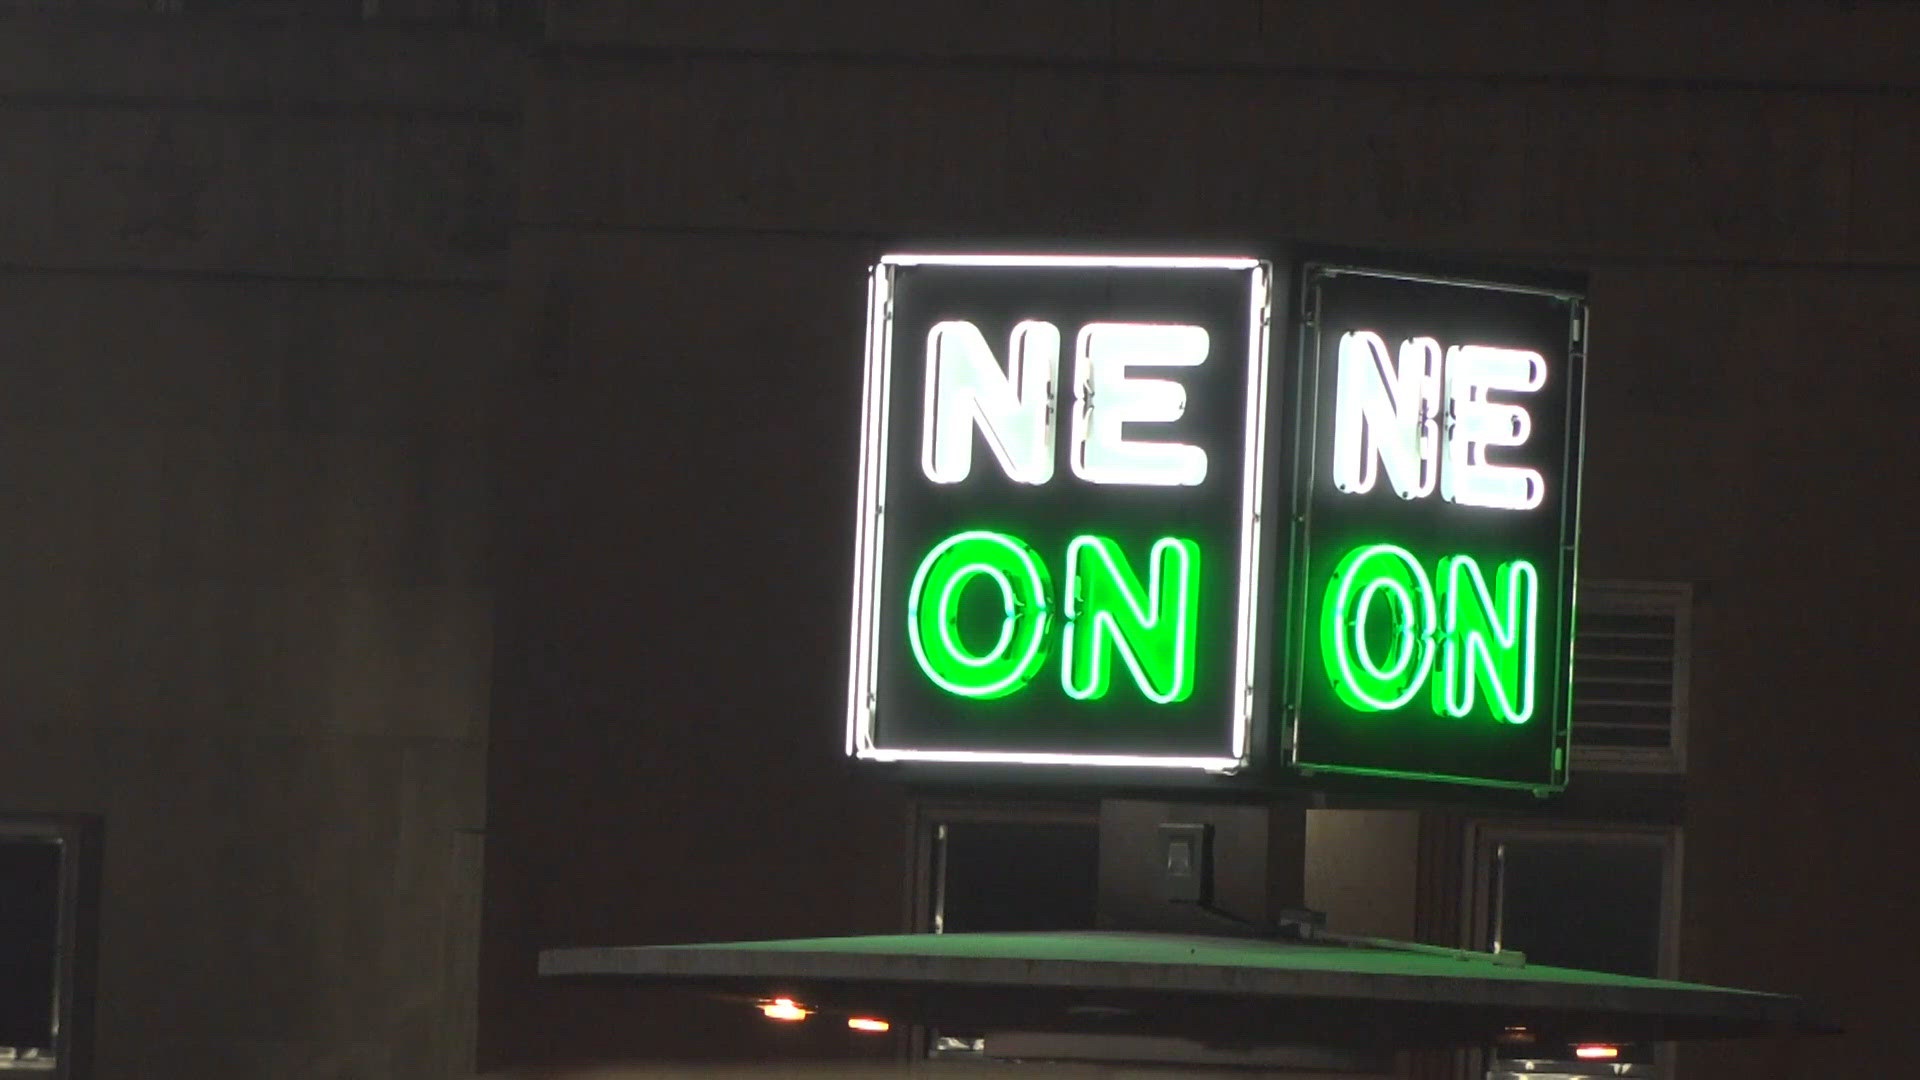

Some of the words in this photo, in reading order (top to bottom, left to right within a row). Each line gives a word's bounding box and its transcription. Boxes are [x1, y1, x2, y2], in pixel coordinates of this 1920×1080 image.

[921, 319, 1209, 486] NE
[1333, 330, 1547, 510] NE
[907, 530, 1200, 704] ON
[1320, 544, 1538, 724] ON
